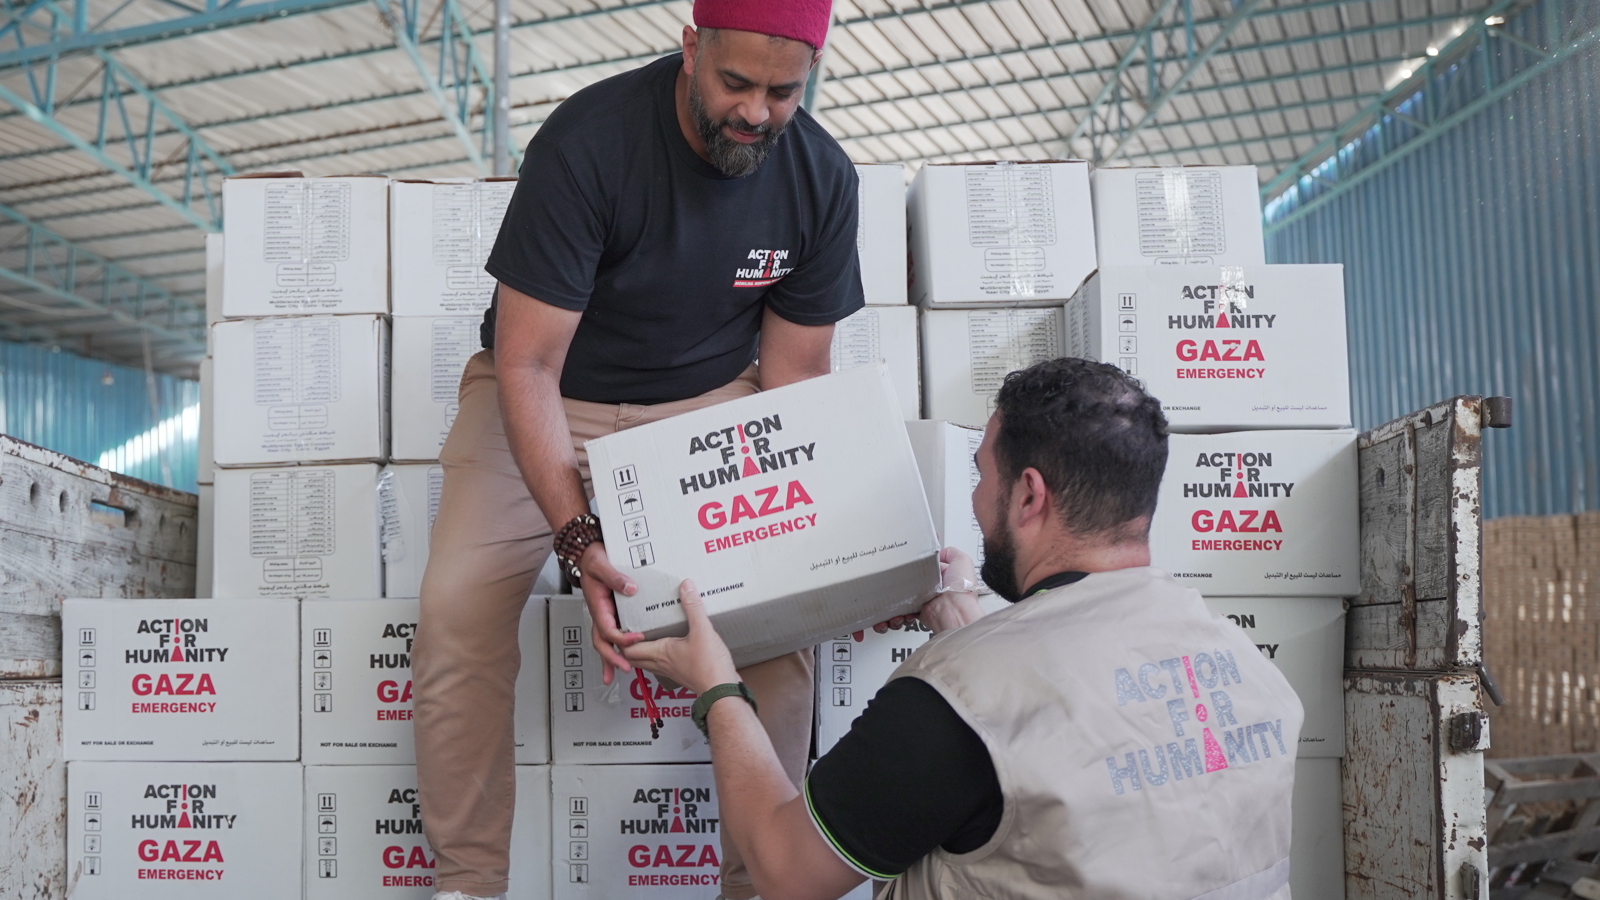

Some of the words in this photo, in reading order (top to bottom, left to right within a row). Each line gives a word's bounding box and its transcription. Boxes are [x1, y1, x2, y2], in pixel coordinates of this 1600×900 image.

[747, 249, 789, 261] ACTION
[1168, 312, 1276, 329] HUMANITY
[1176, 339, 1265, 362] GAZA
[1176, 368, 1265, 379] EMERGENCY
[689, 414, 783, 455] ACTION
[720, 437, 772, 465] FOR
[679, 442, 816, 495] HUMANITY
[1195, 453, 1272, 470] ACTION
[1220, 467, 1260, 482] FOR
[1183, 481, 1294, 498] HUMANITY
[698, 480, 814, 530] GAZA
[1191, 510, 1283, 533] GAZA
[704, 513, 817, 553] EMERGENCY
[859, 547, 877, 557] ليست
[879, 541, 908, 552] مساعدات
[1192, 540, 1283, 551] EMERGENCY
[645, 604, 660, 612] NOT
[661, 600, 676, 608] FOR
[707, 582, 744, 596] EXCHANGE
[137, 618, 208, 636] ACTION
[382, 623, 418, 638] ACT
[159, 633, 196, 648] FOR
[125, 647, 229, 664] HUMANITY
[131, 673, 217, 697] GAZA
[1114, 648, 1242, 706] ACTION
[377, 680, 412, 703] GA
[630, 677, 698, 701] GAZ
[131, 702, 217, 714] EMERGENCY
[1166, 690, 1238, 738] FOR
[1106, 718, 1287, 795] HUMANITY
[144, 784, 216, 800] ACTION
[633, 788, 710, 805] ACTION
[166, 799, 204, 814] FOR
[658, 804, 698, 818] FOR
[131, 811, 237, 829] HUMANITY
[620, 816, 719, 834] HUMANIT
[137, 839, 224, 863] GAZA
[383, 846, 436, 869] GA
[628, 844, 720, 868] GAZA
[137, 868, 224, 880] EMERGENCY
[383, 876, 433, 887] EMERG
[628, 874, 720, 886] EMERGENCY
